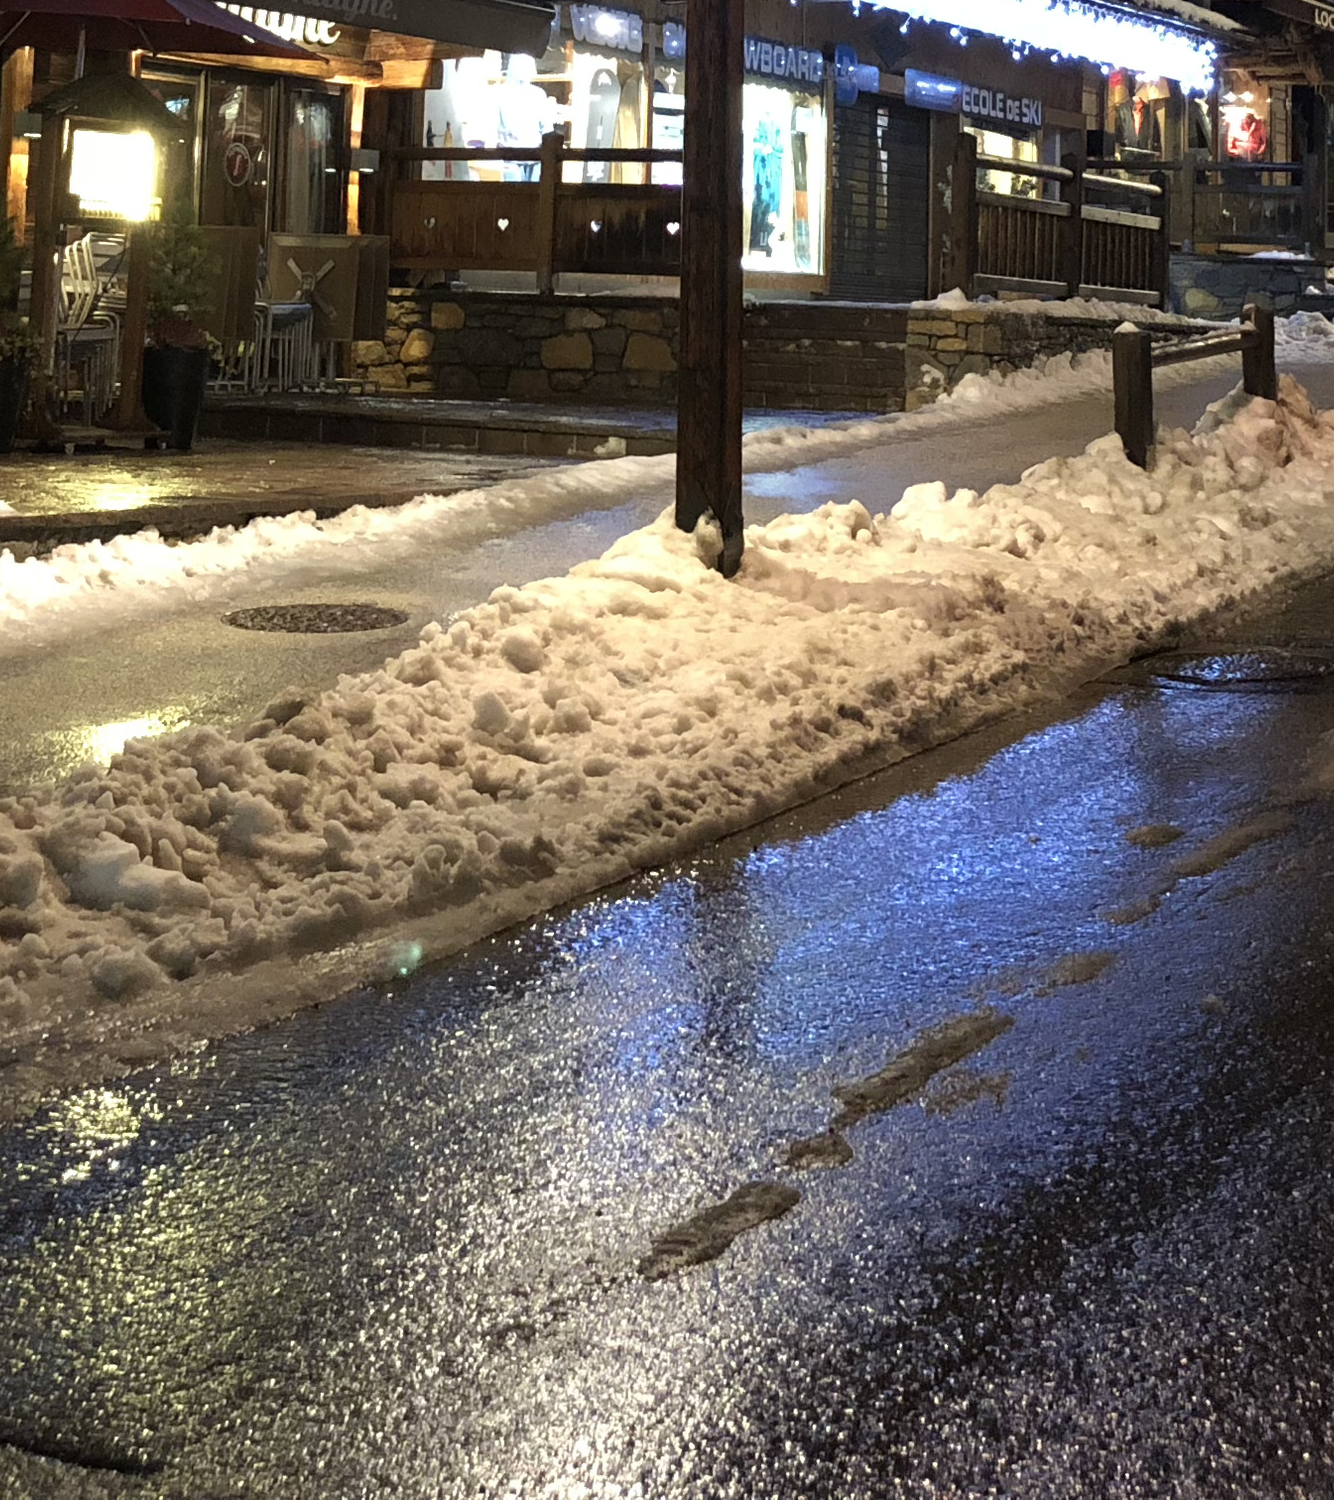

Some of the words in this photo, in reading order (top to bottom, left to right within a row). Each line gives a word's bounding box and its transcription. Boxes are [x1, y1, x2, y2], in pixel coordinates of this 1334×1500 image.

[744, 38, 823, 83] WBOARD
[962, 84, 1005, 119] ECOLE
[1006, 98, 1021, 122] DE
[1021, 97, 1043, 127] SKI
